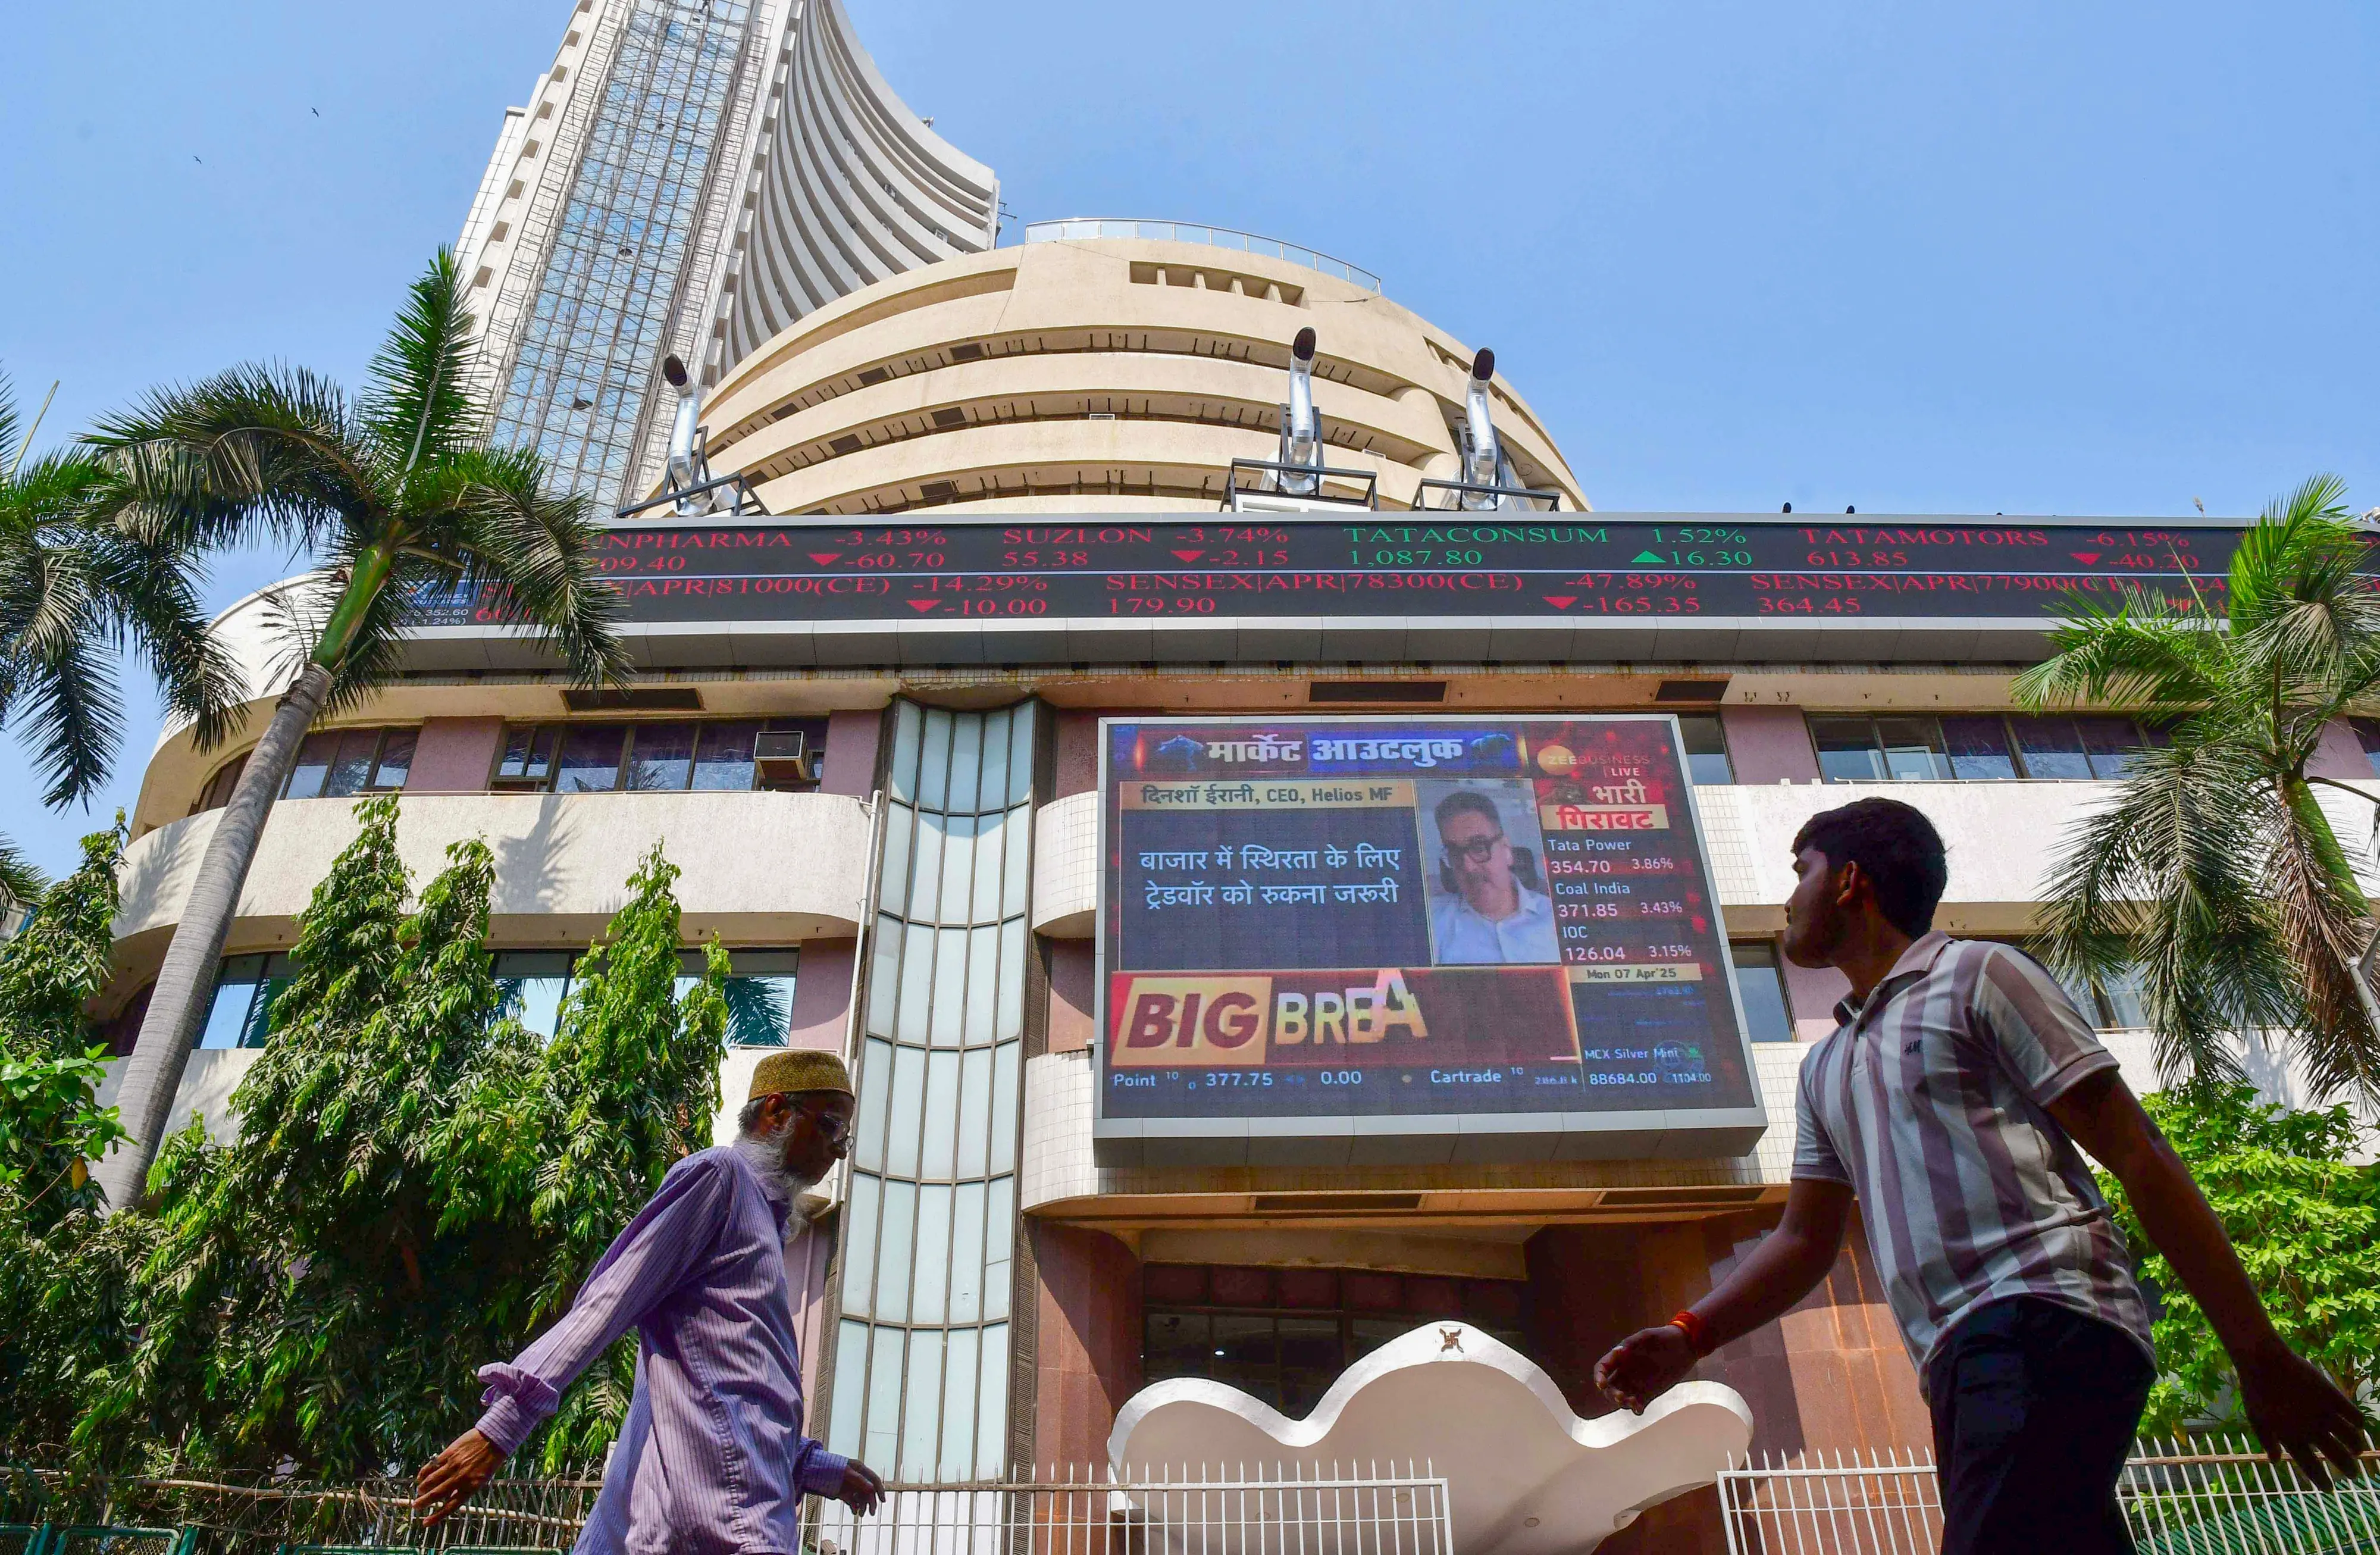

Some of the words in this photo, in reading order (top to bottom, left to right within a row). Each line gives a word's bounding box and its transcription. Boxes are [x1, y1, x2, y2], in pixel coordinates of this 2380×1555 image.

[582, 532, 792, 549] NPHARMA
[835, 530, 946, 546] -3.43%
[1003, 528, 1153, 545] SUZLON
[1176, 528, 1288, 543] -3.74%
[1344, 528, 1609, 543] TATACONSUM
[1654, 528, 1746, 544] 1.52%
[1798, 528, 2048, 546] TATAMOTORS
[2087, 533, 2190, 546] -6.15%
[590, 556, 685, 572] 09.40
[844, 552, 945, 568] -60.70
[1002, 551, 1088, 567] 55.38
[1209, 550, 1288, 565] -2.15
[1349, 550, 1482, 568] 1,087.80
[1671, 551, 1753, 566] 16.30
[1807, 551, 1908, 567] 613.85
[2109, 553, 2199, 569] -40.20
[595, 575, 890, 599] X|APR|81000(CE)
[913, 576, 1048, 593] -14.29%
[1107, 573, 1522, 593] SENSEX|APR|78300(CE)
[1565, 573, 1697, 589] -47.89%
[1750, 574, 2142, 594] SENSEX|APR|77900(CE)
[944, 599, 1047, 615] -10.00
[1110, 597, 1216, 614] 179.90
[1583, 597, 1700, 612] -165.35
[1759, 597, 1861, 613] 364.45
[1207, 734, 1303, 762] मार्केट
[1312, 739, 1463, 767] आउटलुक
[1611, 768, 1640, 777] LIVE
[1141, 784, 1200, 803] दिनशॉ
[1266, 789, 1305, 805] CEO,
[1312, 787, 1363, 802] Helios
[1369, 787, 1393, 801] MF
[1592, 778, 1646, 803] भारी
[1555, 805, 1654, 829] गिरावट
[1548, 839, 1580, 851] Tata
[1586, 839, 1631, 851] Power
[1139, 851, 1208, 870] बाजार
[1214, 845, 1234, 869] में
[1240, 844, 1318, 870] स्थिरता
[1324, 844, 1348, 869] के
[1354, 843, 1401, 871] लिए
[1551, 861, 1611, 874] 354.70
[1631, 858, 1674, 869] 3.86%
[1221, 880, 1253, 905] को
[1260, 885, 1326, 905] रुकना
[1333, 877, 1399, 903] जरूरी
[1556, 883, 1588, 895] Coal
[1595, 882, 1630, 894] India
[1558, 904, 1618, 918] 371.85
[1640, 901, 1683, 913] 3.43%
[1563, 926, 1588, 938] IOC
[1565, 947, 1626, 960] 126.04
[1648, 945, 1692, 958] 3.15%
[1587, 969, 1609, 980] Mon
[1615, 969, 1630, 979] 07
[1636, 968, 1677, 980] Apr'25
[1126, 991, 1260, 1049] BIG
[1274, 968, 1428, 1046] BREA
[1584, 1050, 1609, 1060] MCX
[1615, 1049, 1648, 1059] Silver
[1654, 1047, 1678, 1057] Mini
[1113, 1074, 1156, 1087] Point
[1206, 1073, 1273, 1086] 377.75
[1321, 1071, 1361, 1084] 0.00
[1430, 1069, 1501, 1084] Cartrade
[1511, 1067, 1523, 1075] 10
[1590, 1072, 1657, 1085] 88684.00
